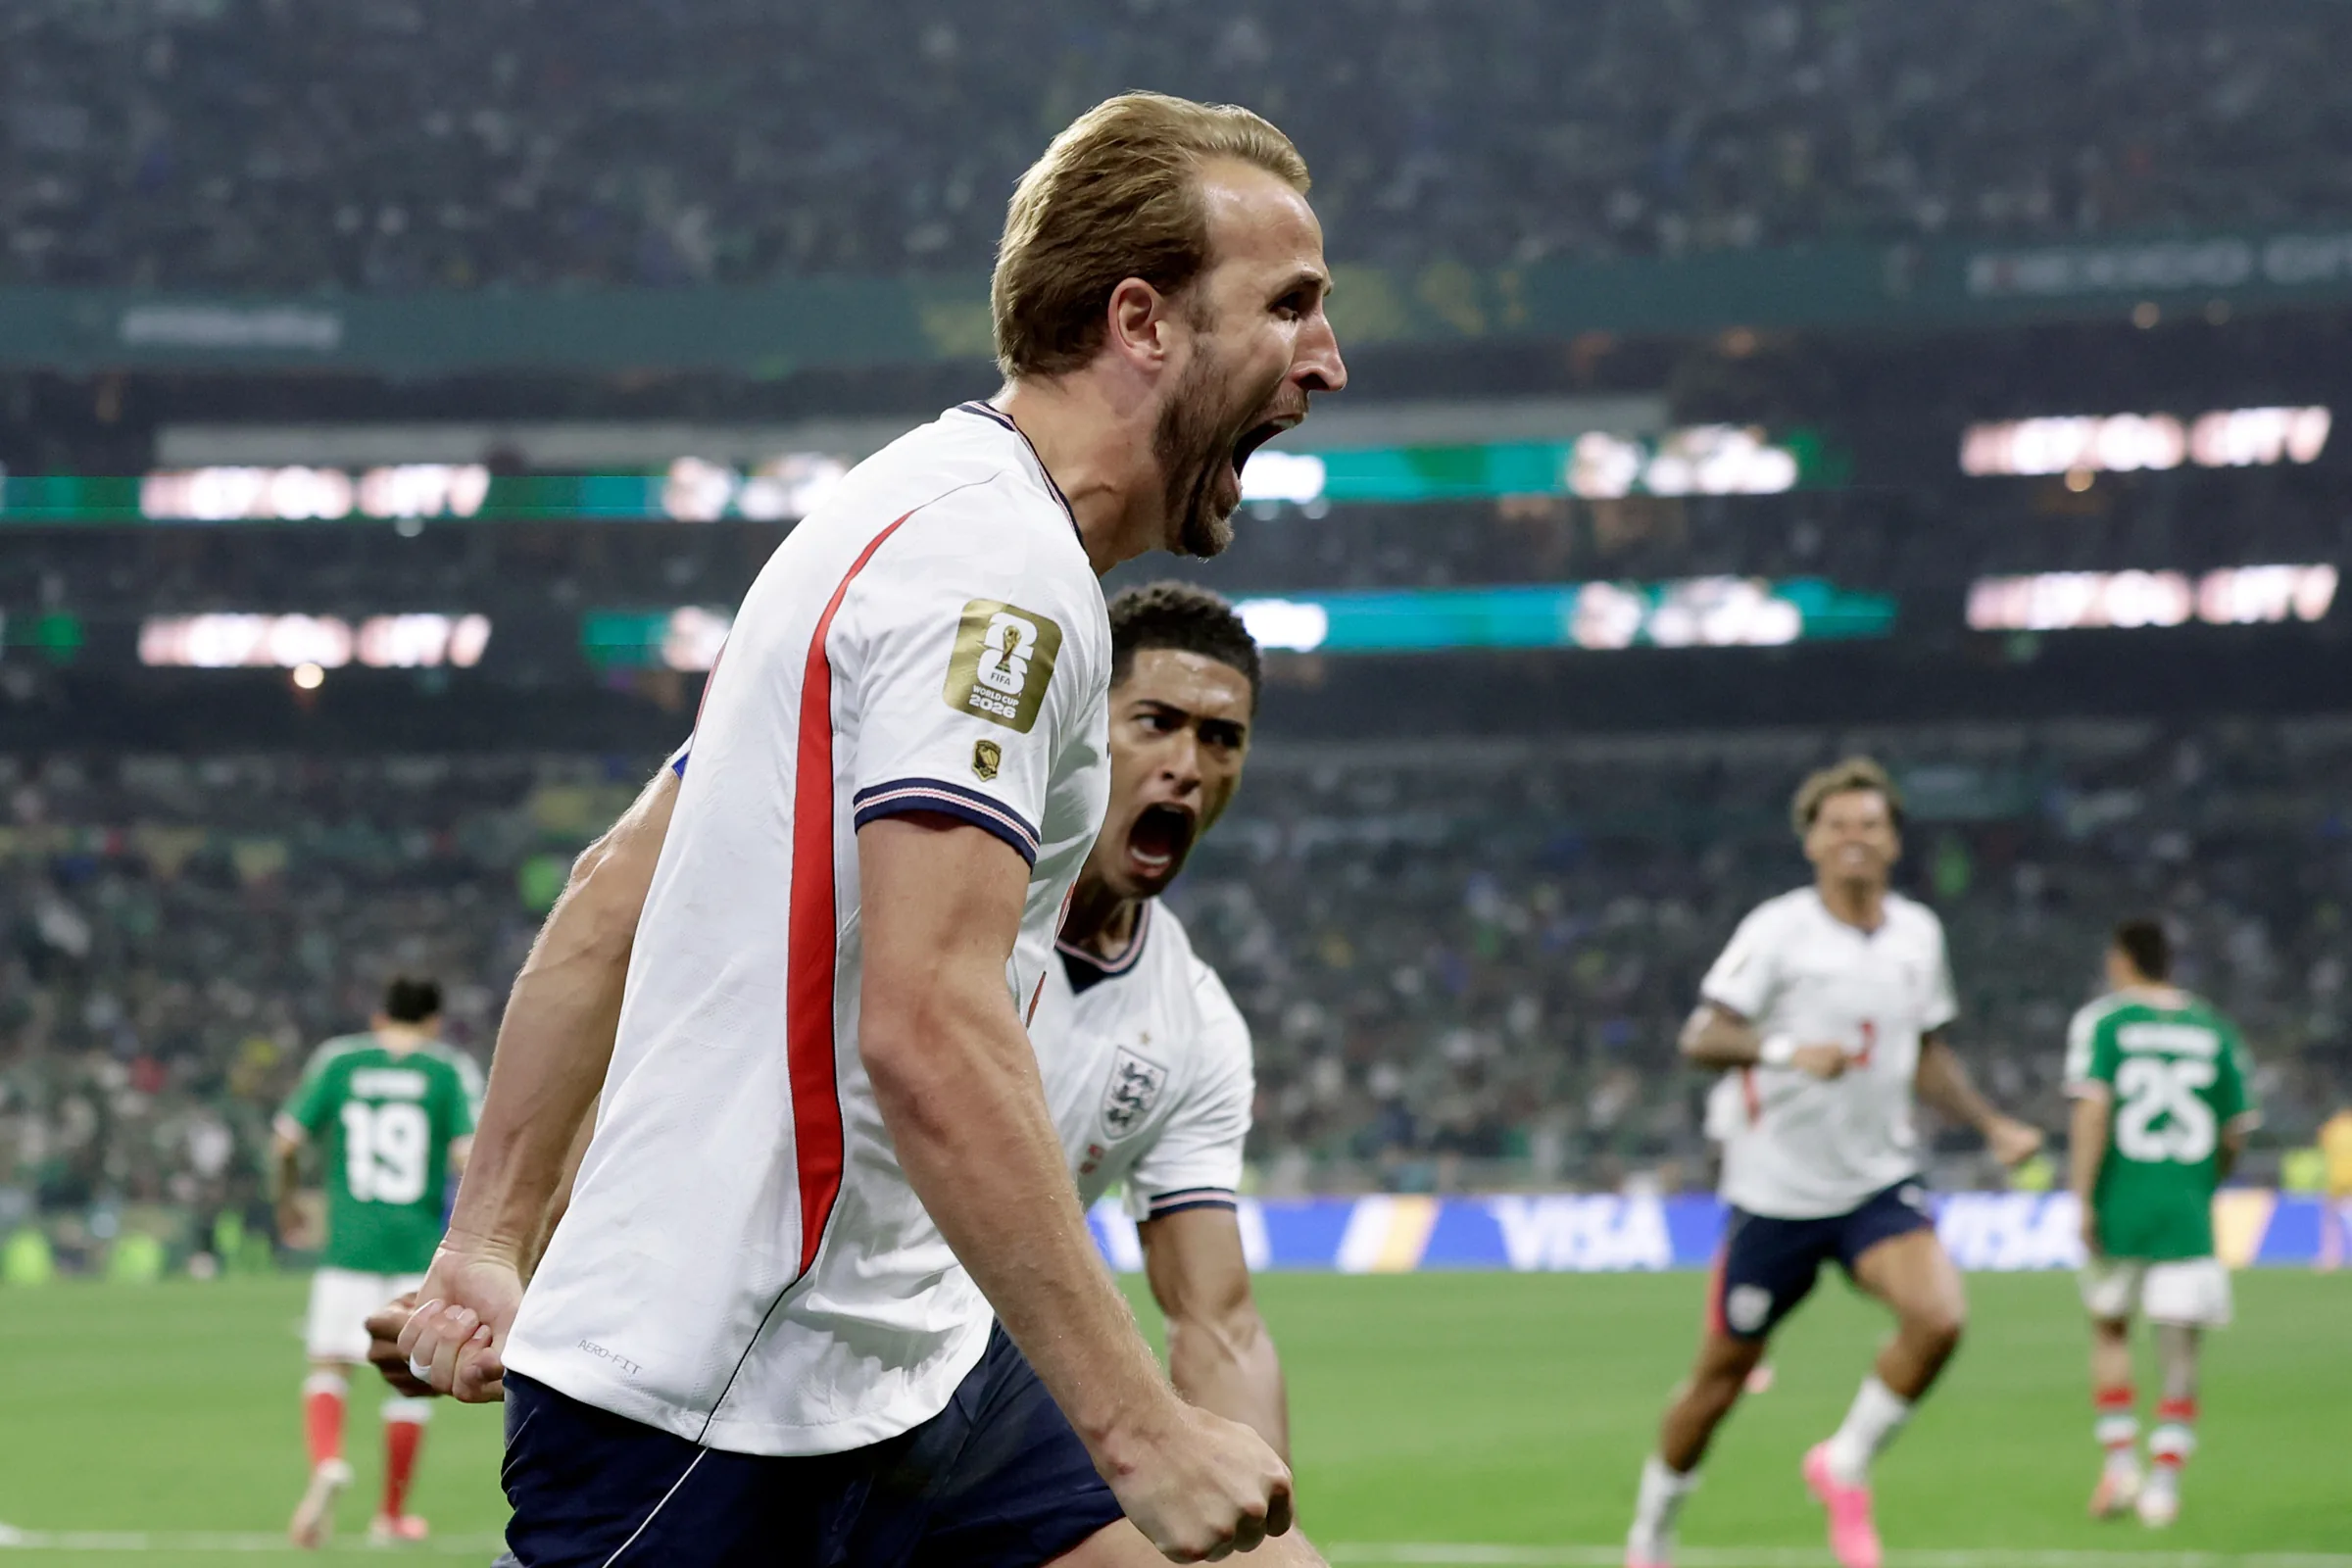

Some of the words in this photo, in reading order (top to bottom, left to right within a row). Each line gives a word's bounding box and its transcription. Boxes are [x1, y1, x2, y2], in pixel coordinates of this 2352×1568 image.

[973, 684, 1002, 702] WORLD
[1002, 695, 1019, 707] CUP
[990, 672, 1011, 686] FIFA
[968, 694, 1017, 719] 2026
[2114, 1056, 2218, 1164] 25
[341, 1101, 429, 1204] 19
[1489, 1195, 1673, 1271] VISA
[577, 1339, 643, 1375] AERO-FIT
